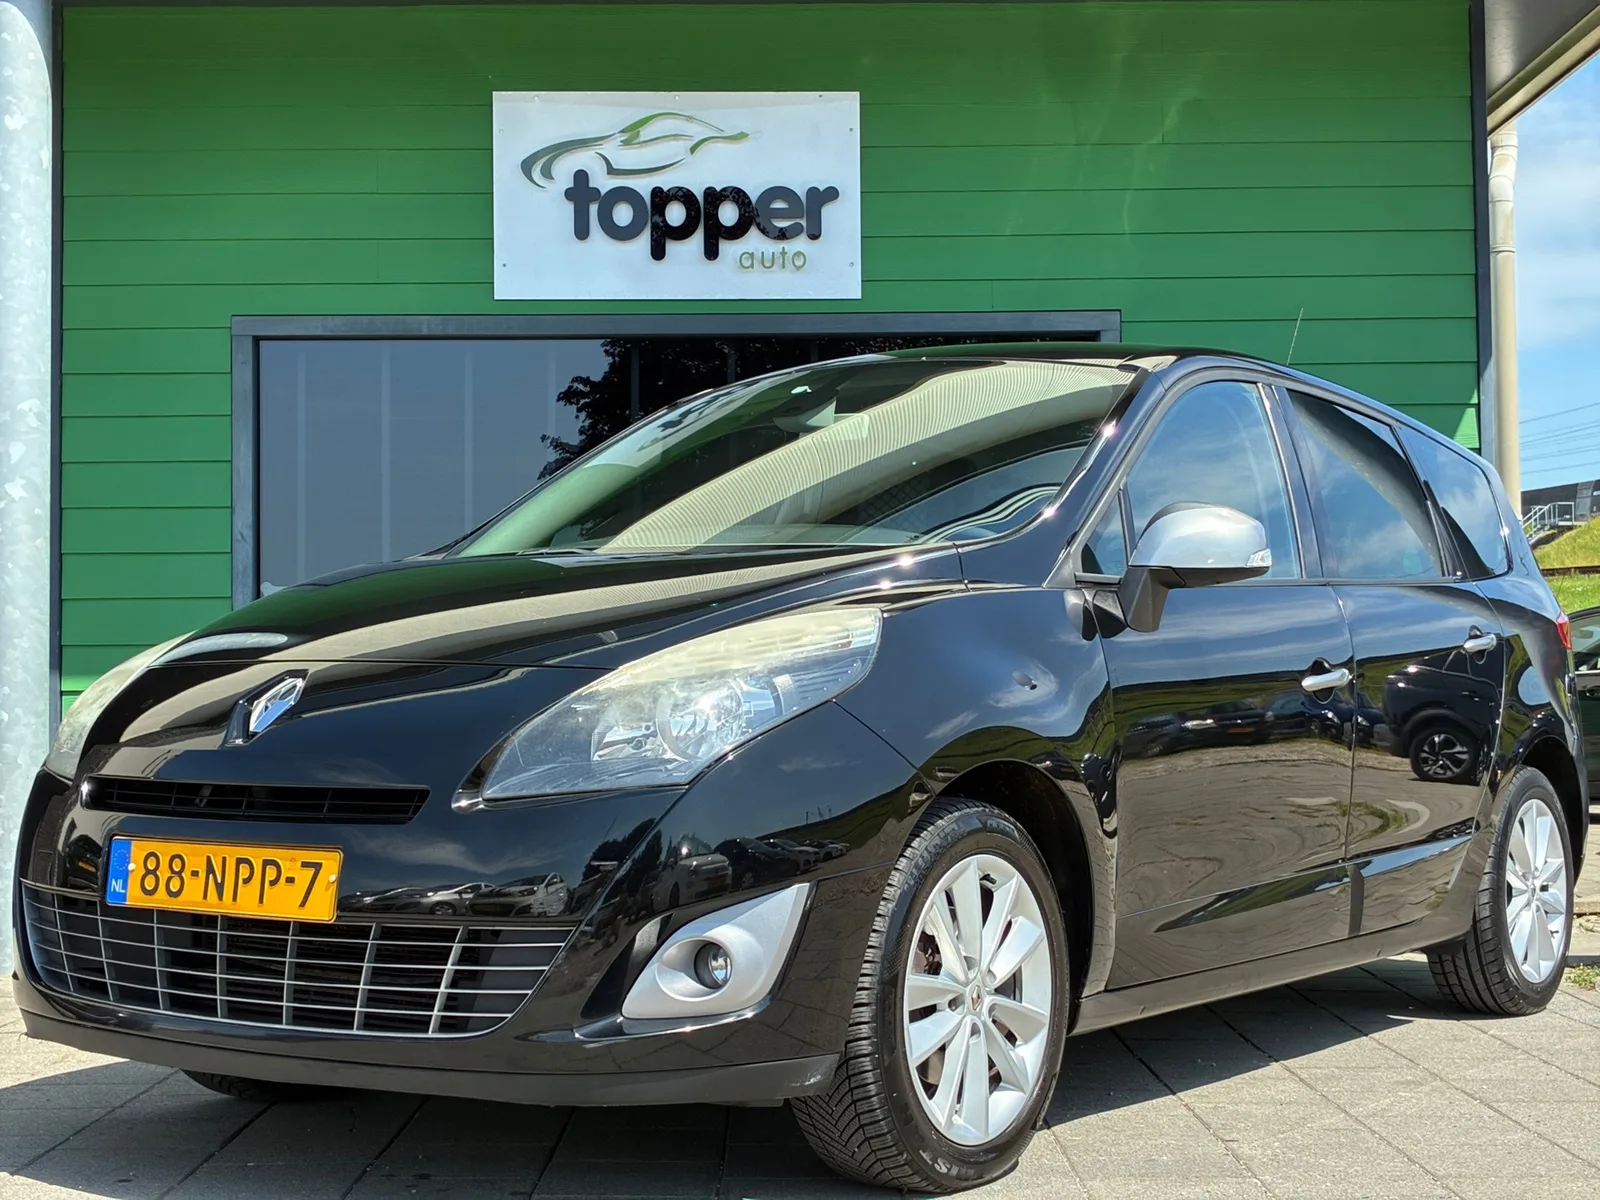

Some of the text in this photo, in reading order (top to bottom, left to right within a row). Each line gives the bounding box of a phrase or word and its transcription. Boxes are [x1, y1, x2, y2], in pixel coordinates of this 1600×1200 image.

[564, 169, 839, 261] topper
[739, 247, 807, 270] auto
[111, 878, 125, 893] NL
[140, 851, 323, 908] 88-NPP-7
